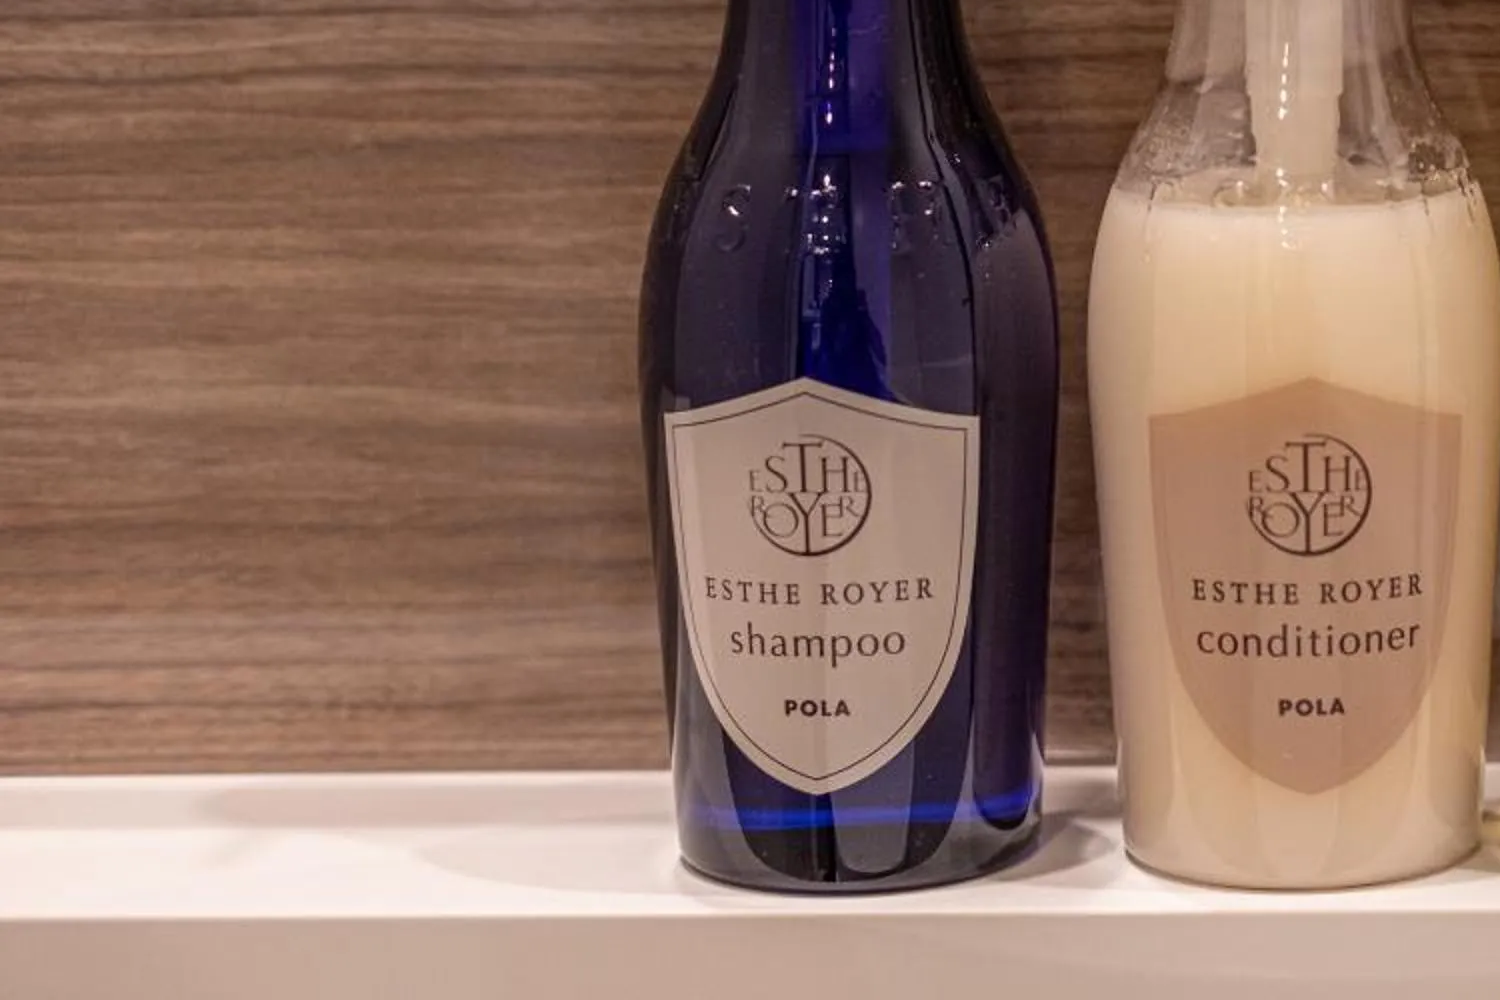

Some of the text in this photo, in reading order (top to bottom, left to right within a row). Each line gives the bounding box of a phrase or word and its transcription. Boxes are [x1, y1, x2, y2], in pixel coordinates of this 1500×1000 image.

[705, 576, 935, 606] ESTHE ROYER
[1191, 572, 1424, 606] ESTHE ROYER
[730, 621, 906, 668] shampoo
[1196, 623, 1421, 658] conditioner
[783, 698, 851, 718] POLA
[1277, 697, 1346, 718] POLA
